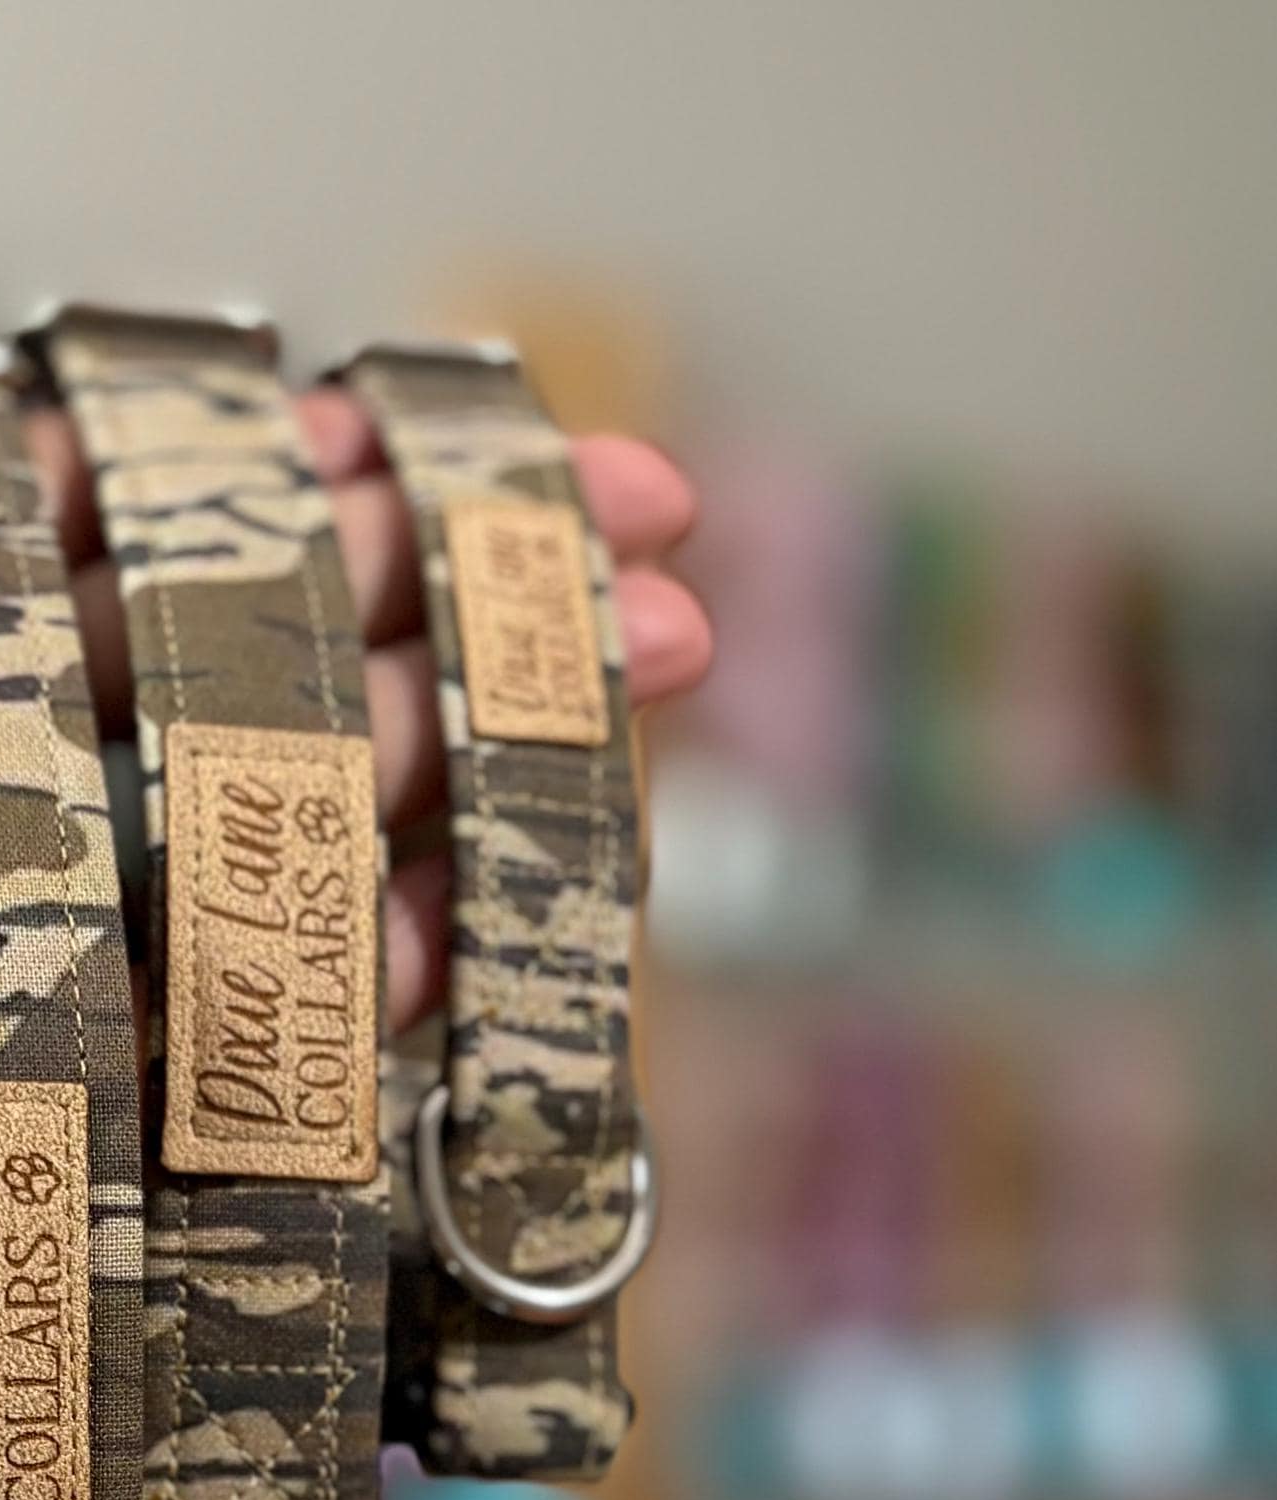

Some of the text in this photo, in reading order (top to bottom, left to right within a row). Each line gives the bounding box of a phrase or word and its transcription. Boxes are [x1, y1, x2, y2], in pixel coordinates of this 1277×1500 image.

[195, 774, 291, 1128] Dixie Lane
[295, 869, 349, 1131] COLLARS
